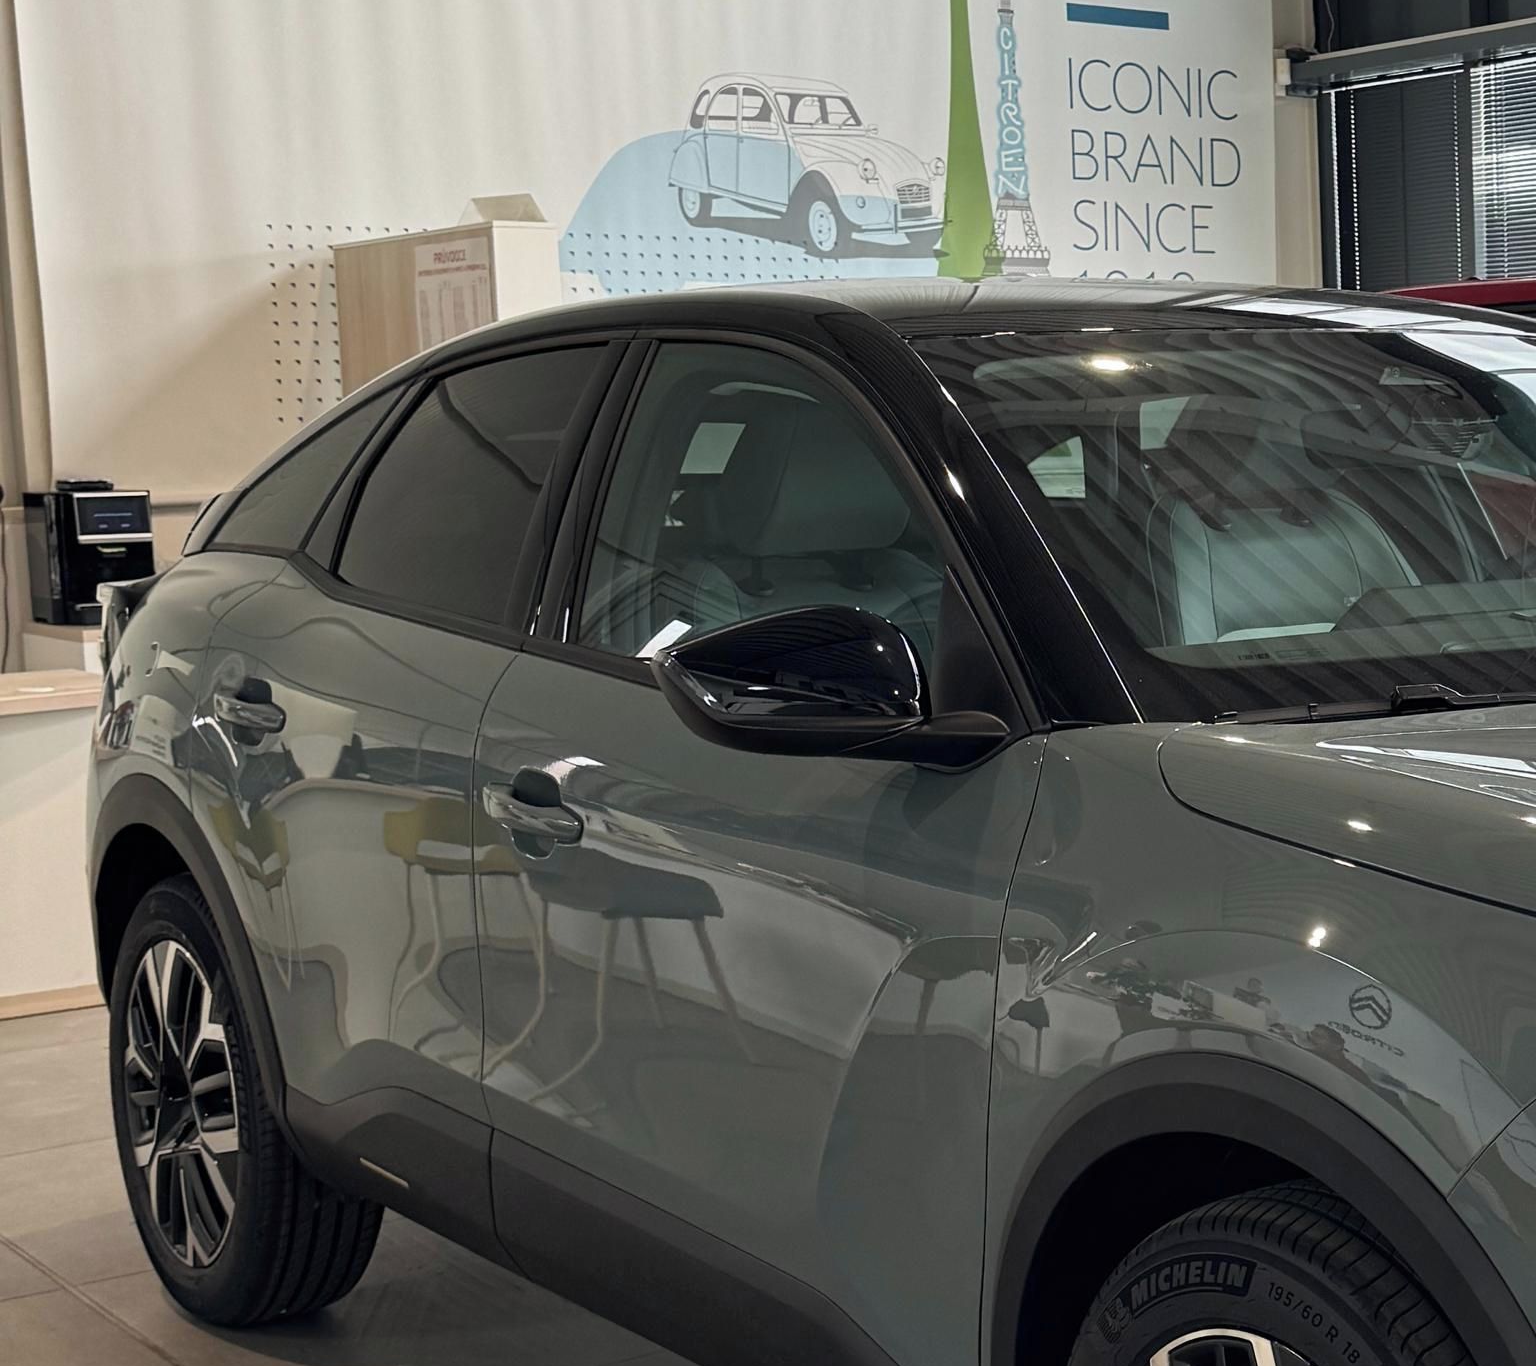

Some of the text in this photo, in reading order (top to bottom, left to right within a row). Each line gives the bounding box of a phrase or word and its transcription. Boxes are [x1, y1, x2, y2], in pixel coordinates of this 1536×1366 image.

[1068, 58, 1238, 120] ICONIC
[1071, 129, 1241, 187] BRAND
[1073, 199, 1216, 254] SINCE
[1131, 1260, 1248, 1309] MICHELIN
[1268, 1282, 1361, 1365] 195/60 R 18
